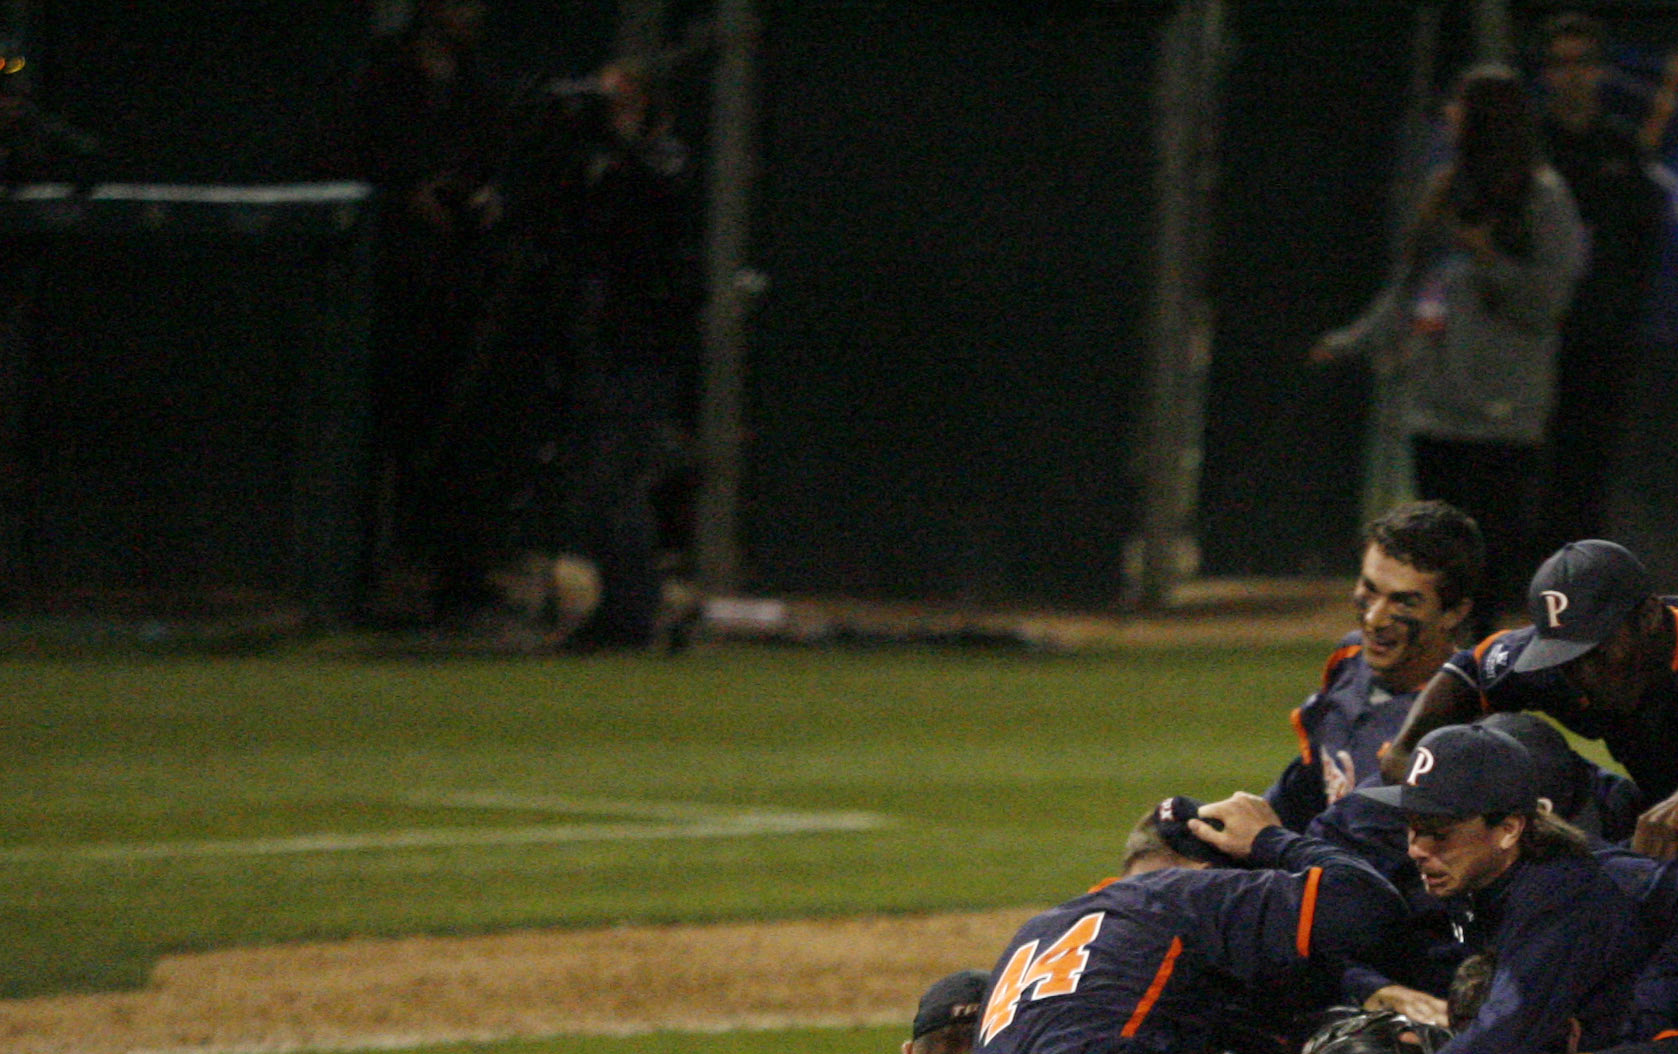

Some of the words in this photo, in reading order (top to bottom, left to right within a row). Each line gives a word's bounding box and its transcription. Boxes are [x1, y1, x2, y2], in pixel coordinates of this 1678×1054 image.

[1540, 590, 1568, 628] P
[1407, 746, 1435, 786] P
[979, 911, 1106, 1047] 44
